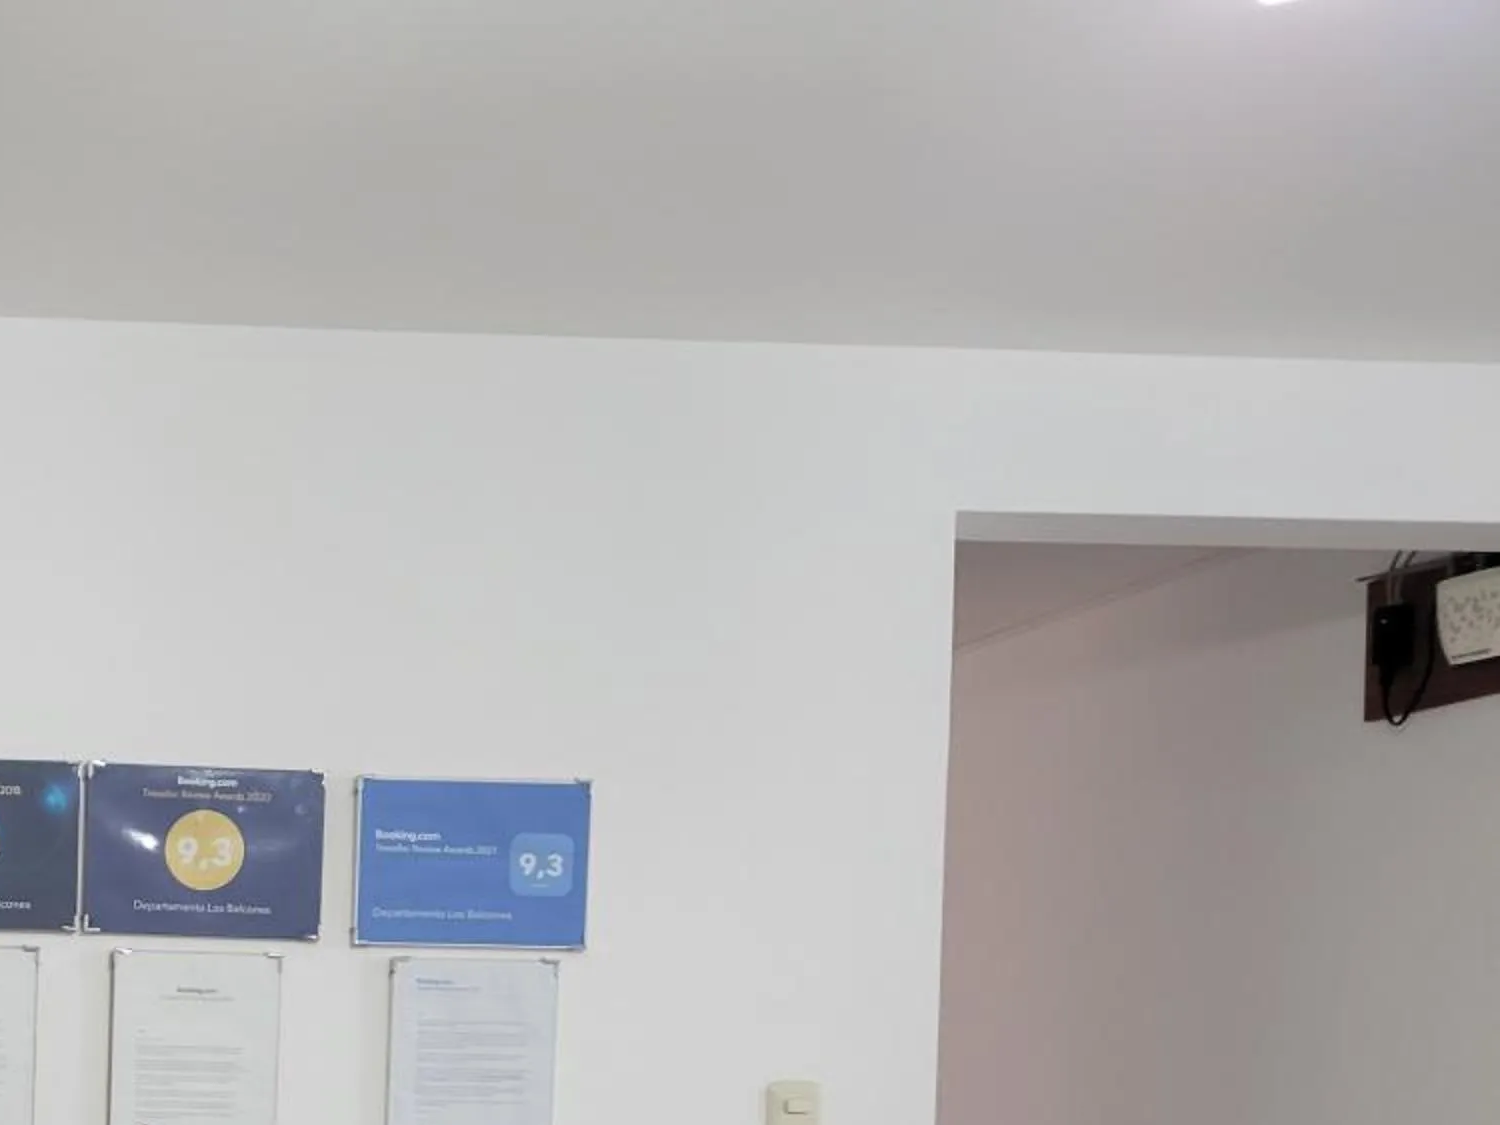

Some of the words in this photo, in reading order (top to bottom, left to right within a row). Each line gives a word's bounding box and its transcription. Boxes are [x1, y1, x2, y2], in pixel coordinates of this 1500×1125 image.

[177, 775, 238, 789] Booking.com
[375, 829, 441, 843] Booking.com
[519, 853, 564, 880] 9,3
[133, 899, 205, 914] Departamento
